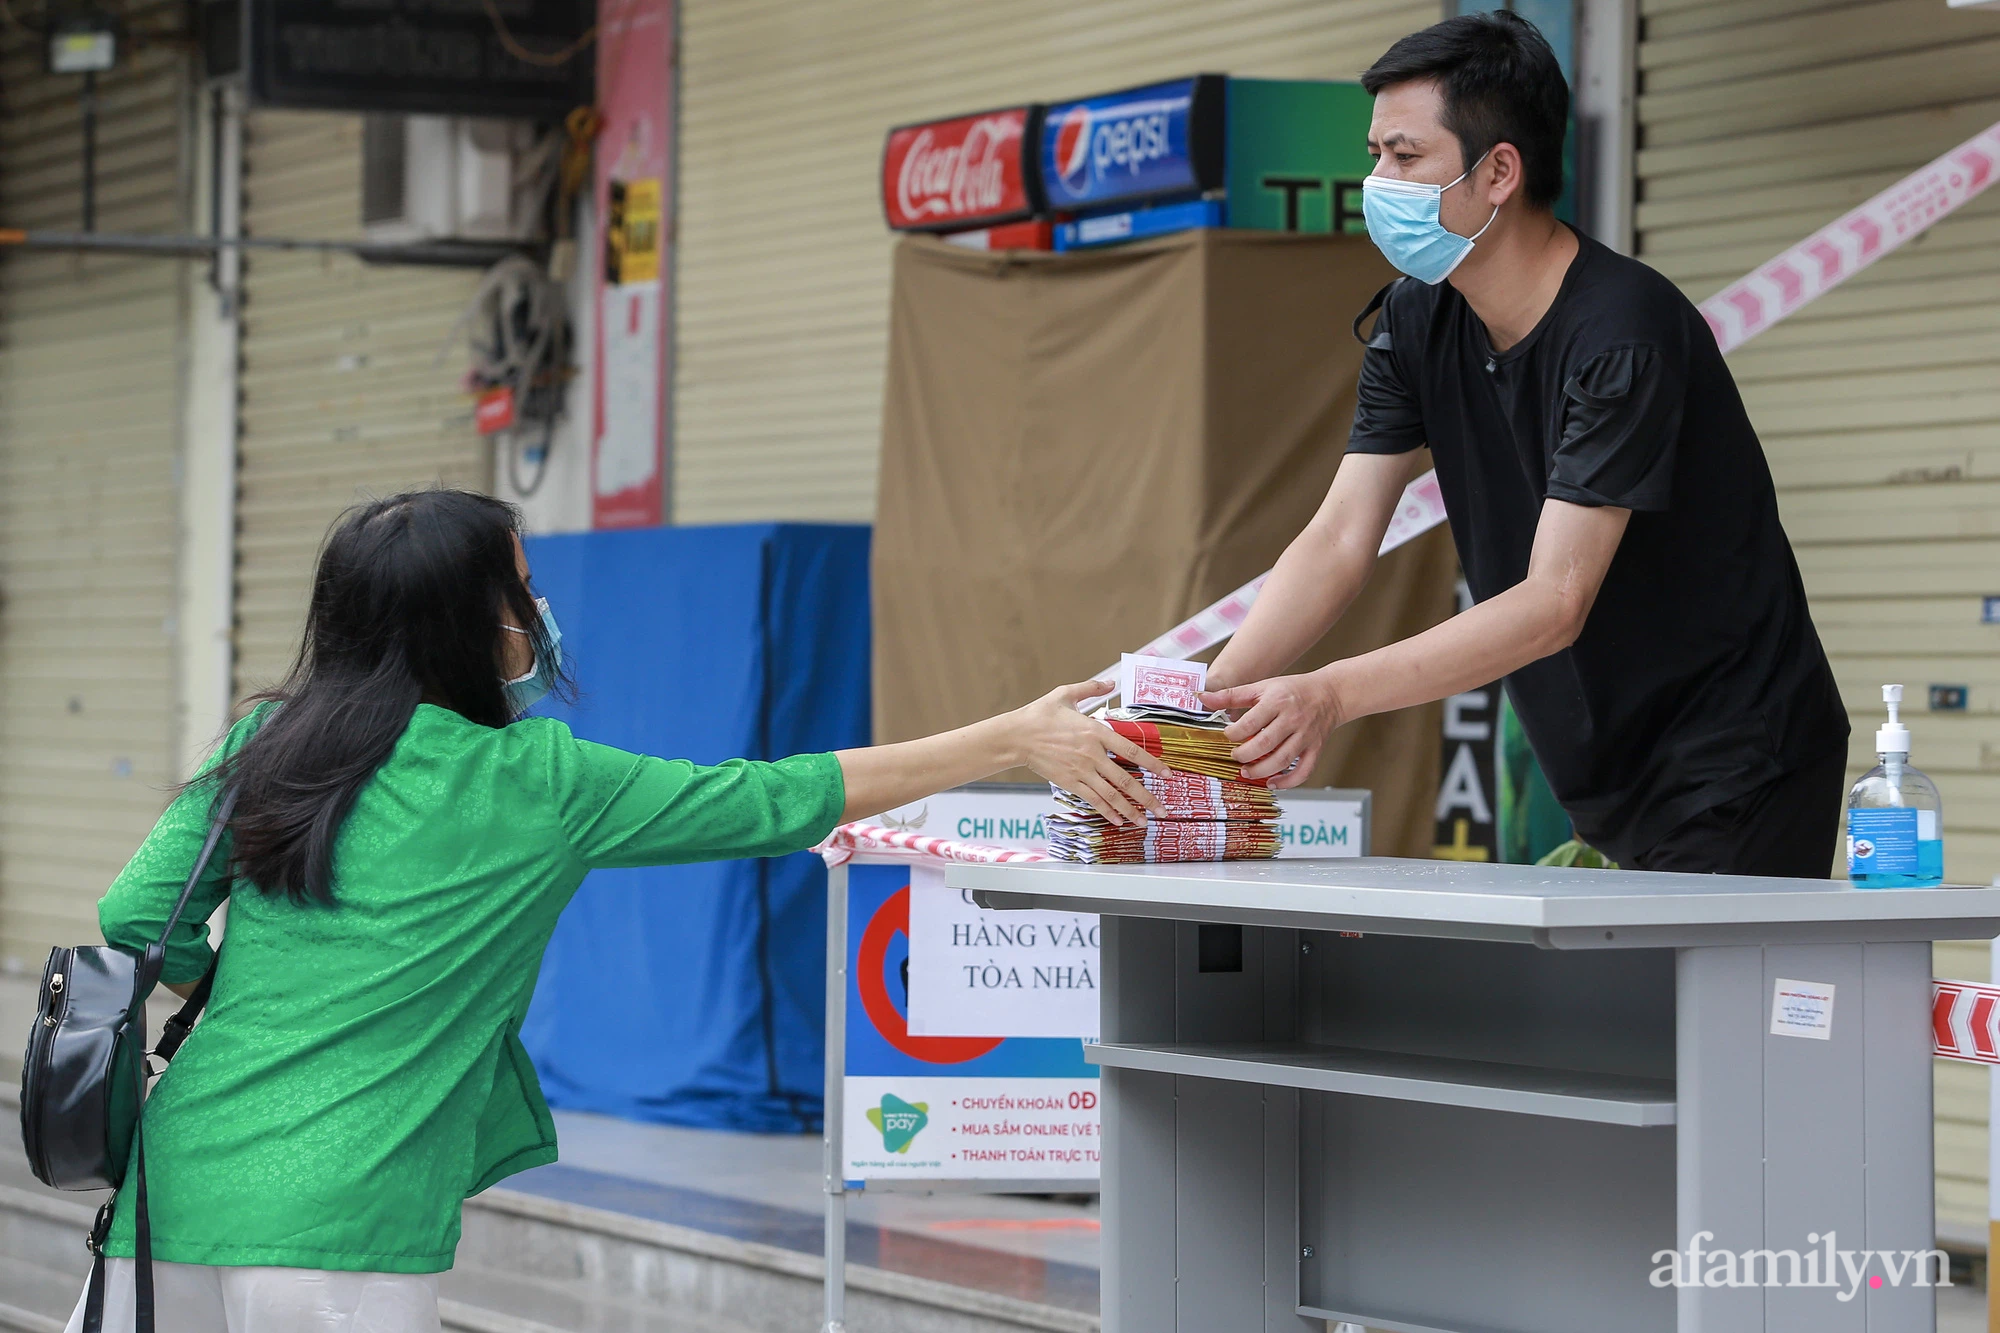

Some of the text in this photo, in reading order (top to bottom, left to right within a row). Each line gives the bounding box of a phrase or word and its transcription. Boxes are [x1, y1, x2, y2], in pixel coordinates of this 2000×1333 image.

[1093, 103, 1171, 182] pepsi
[957, 818, 994, 838] CHI
[1000, 813, 1050, 839] NHÁ
[1299, 820, 1347, 845] ĐÀM
[952, 917, 1036, 948] HÀNG
[963, 959, 1095, 989] TÒA NHÀ
[886, 1118, 916, 1132] pay
[962, 1124, 990, 1135] MUA
[1023, 1124, 1068, 1136] ONLINE
[962, 1149, 1007, 1161] THANH
[1009, 1147, 1045, 1161] TOÁN
[1047, 1148, 1082, 1163] TRỰC
